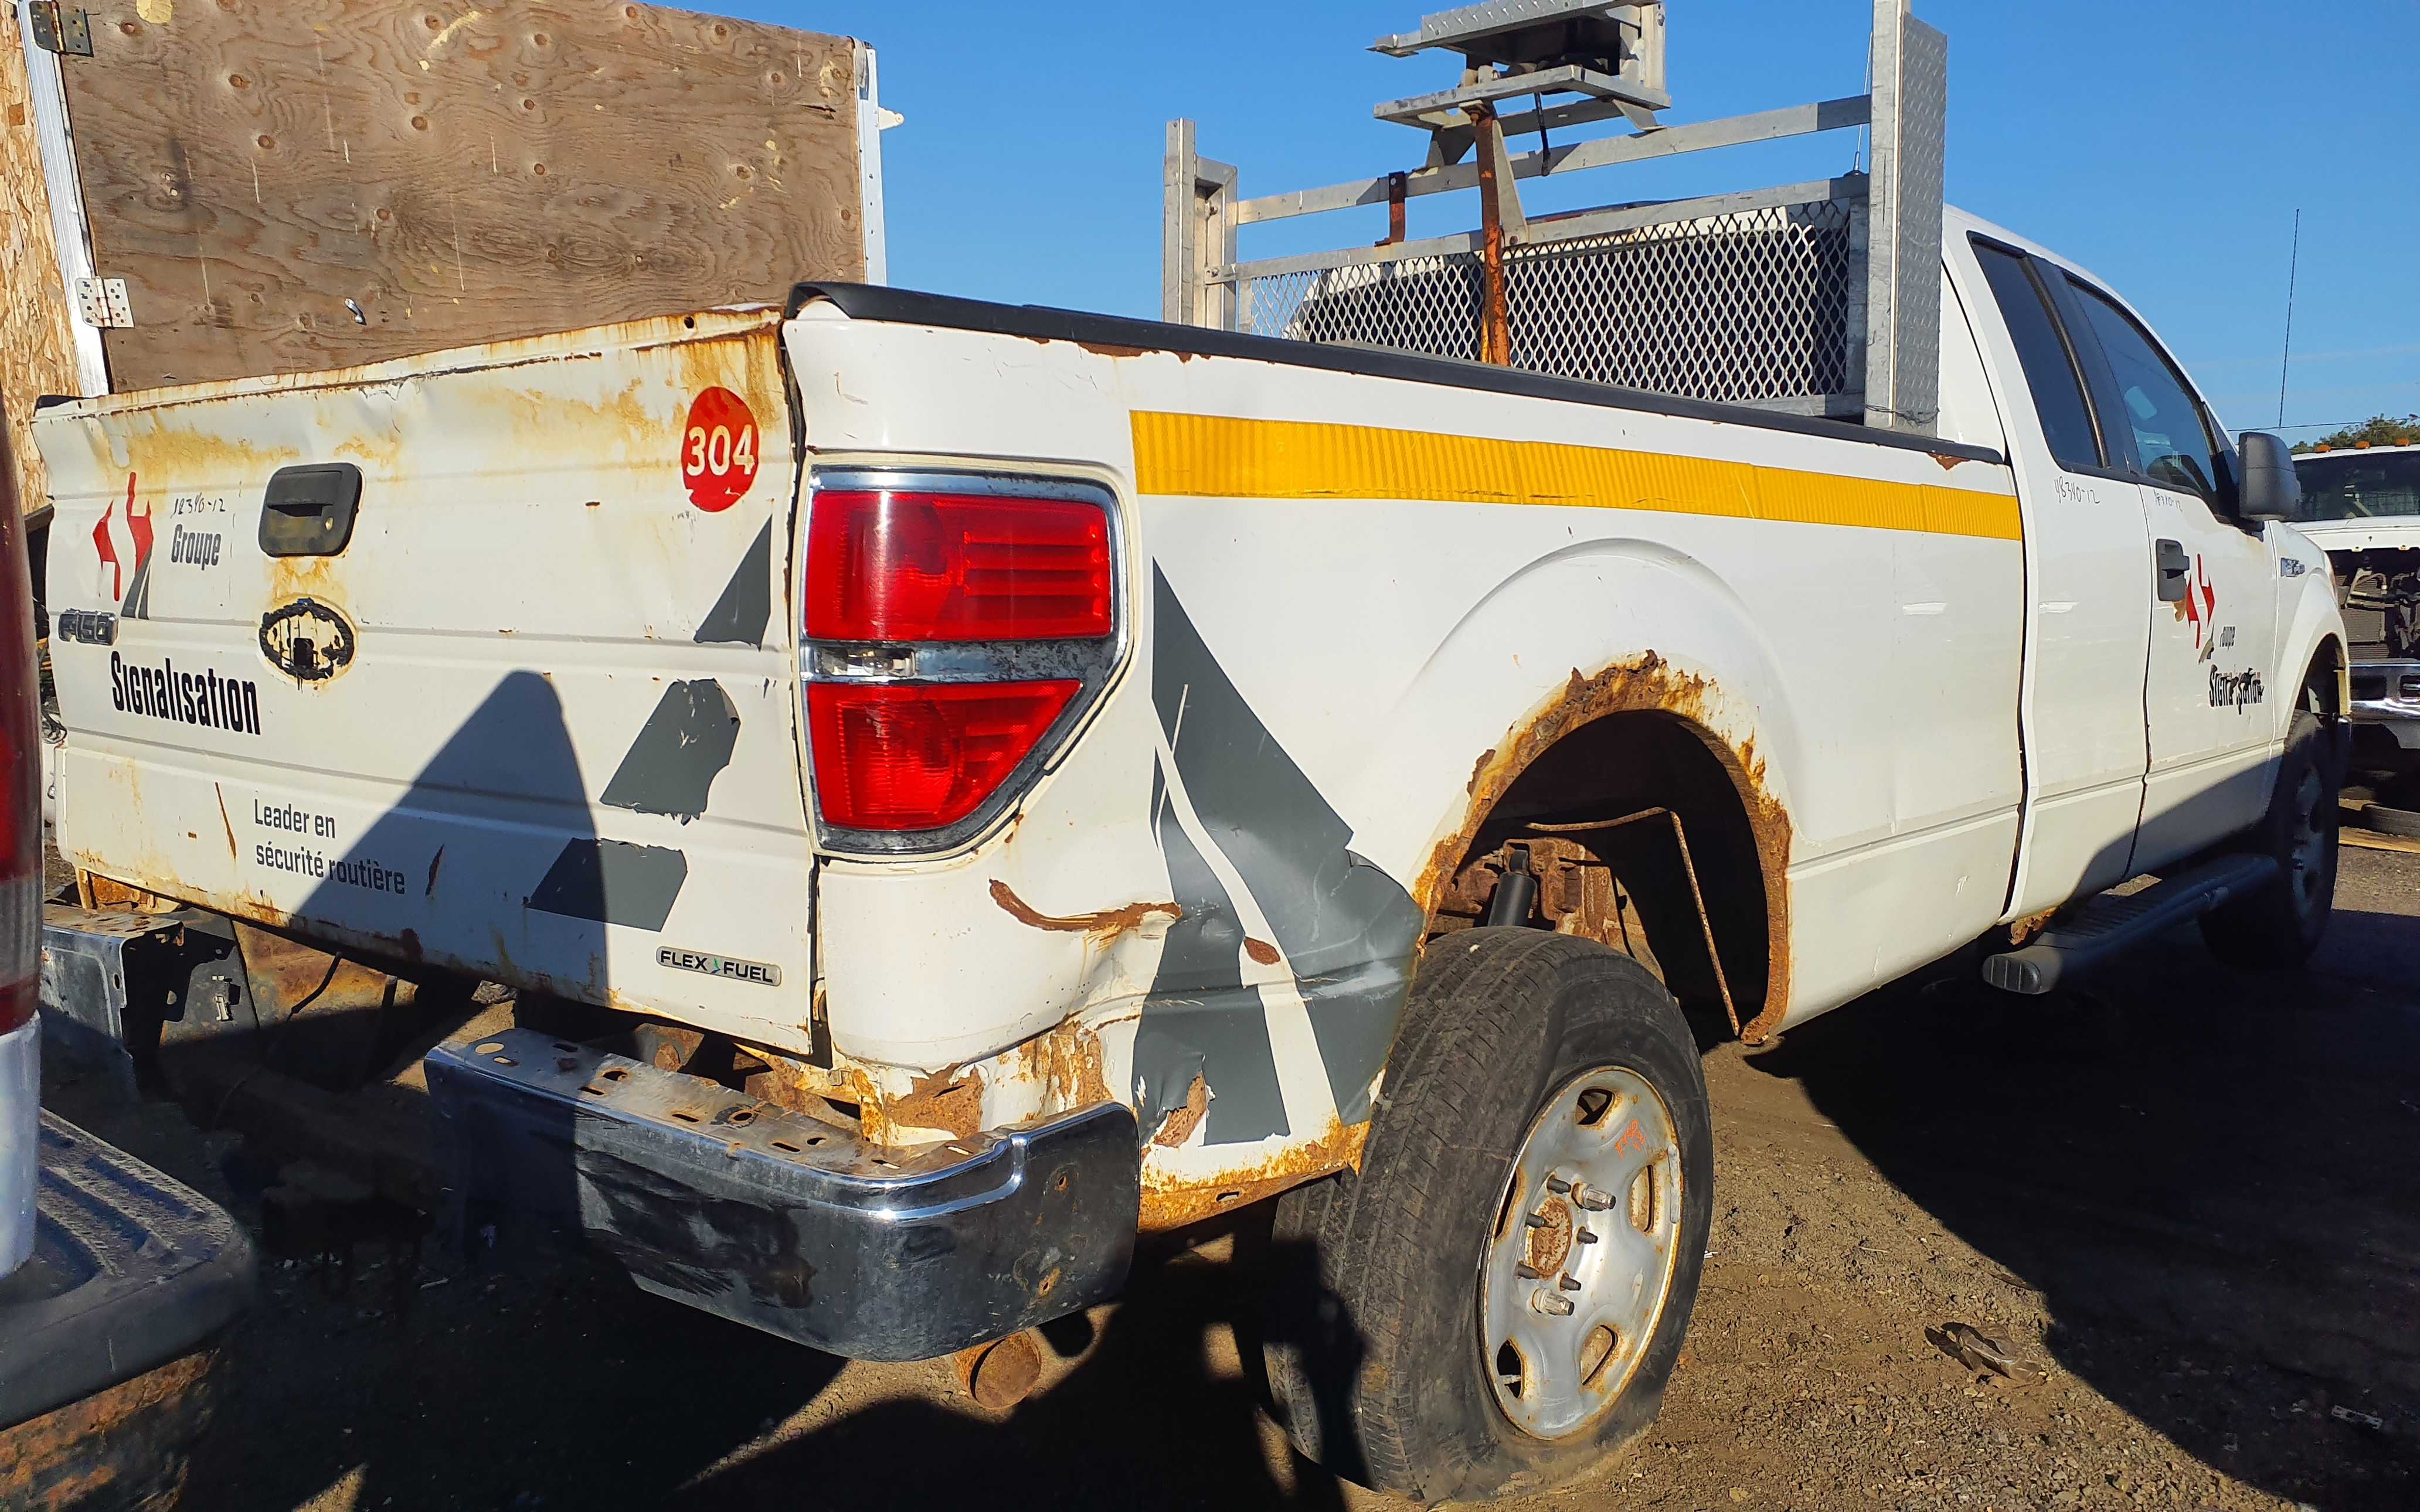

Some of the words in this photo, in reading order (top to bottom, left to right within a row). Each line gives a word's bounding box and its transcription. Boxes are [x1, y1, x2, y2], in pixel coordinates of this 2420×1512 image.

[686, 424, 754, 476] 304
[171, 523, 222, 571] Groupe
[2220, 626, 2236, 650] roupe
[111, 651, 261, 735] Signalisation
[254, 798, 310, 833] Leader
[315, 815, 336, 839] en
[256, 840, 324, 878] sécurité
[328, 858, 406, 895] routière
[661, 949, 708, 970] FLEX
[723, 961, 773, 983] FUEL
